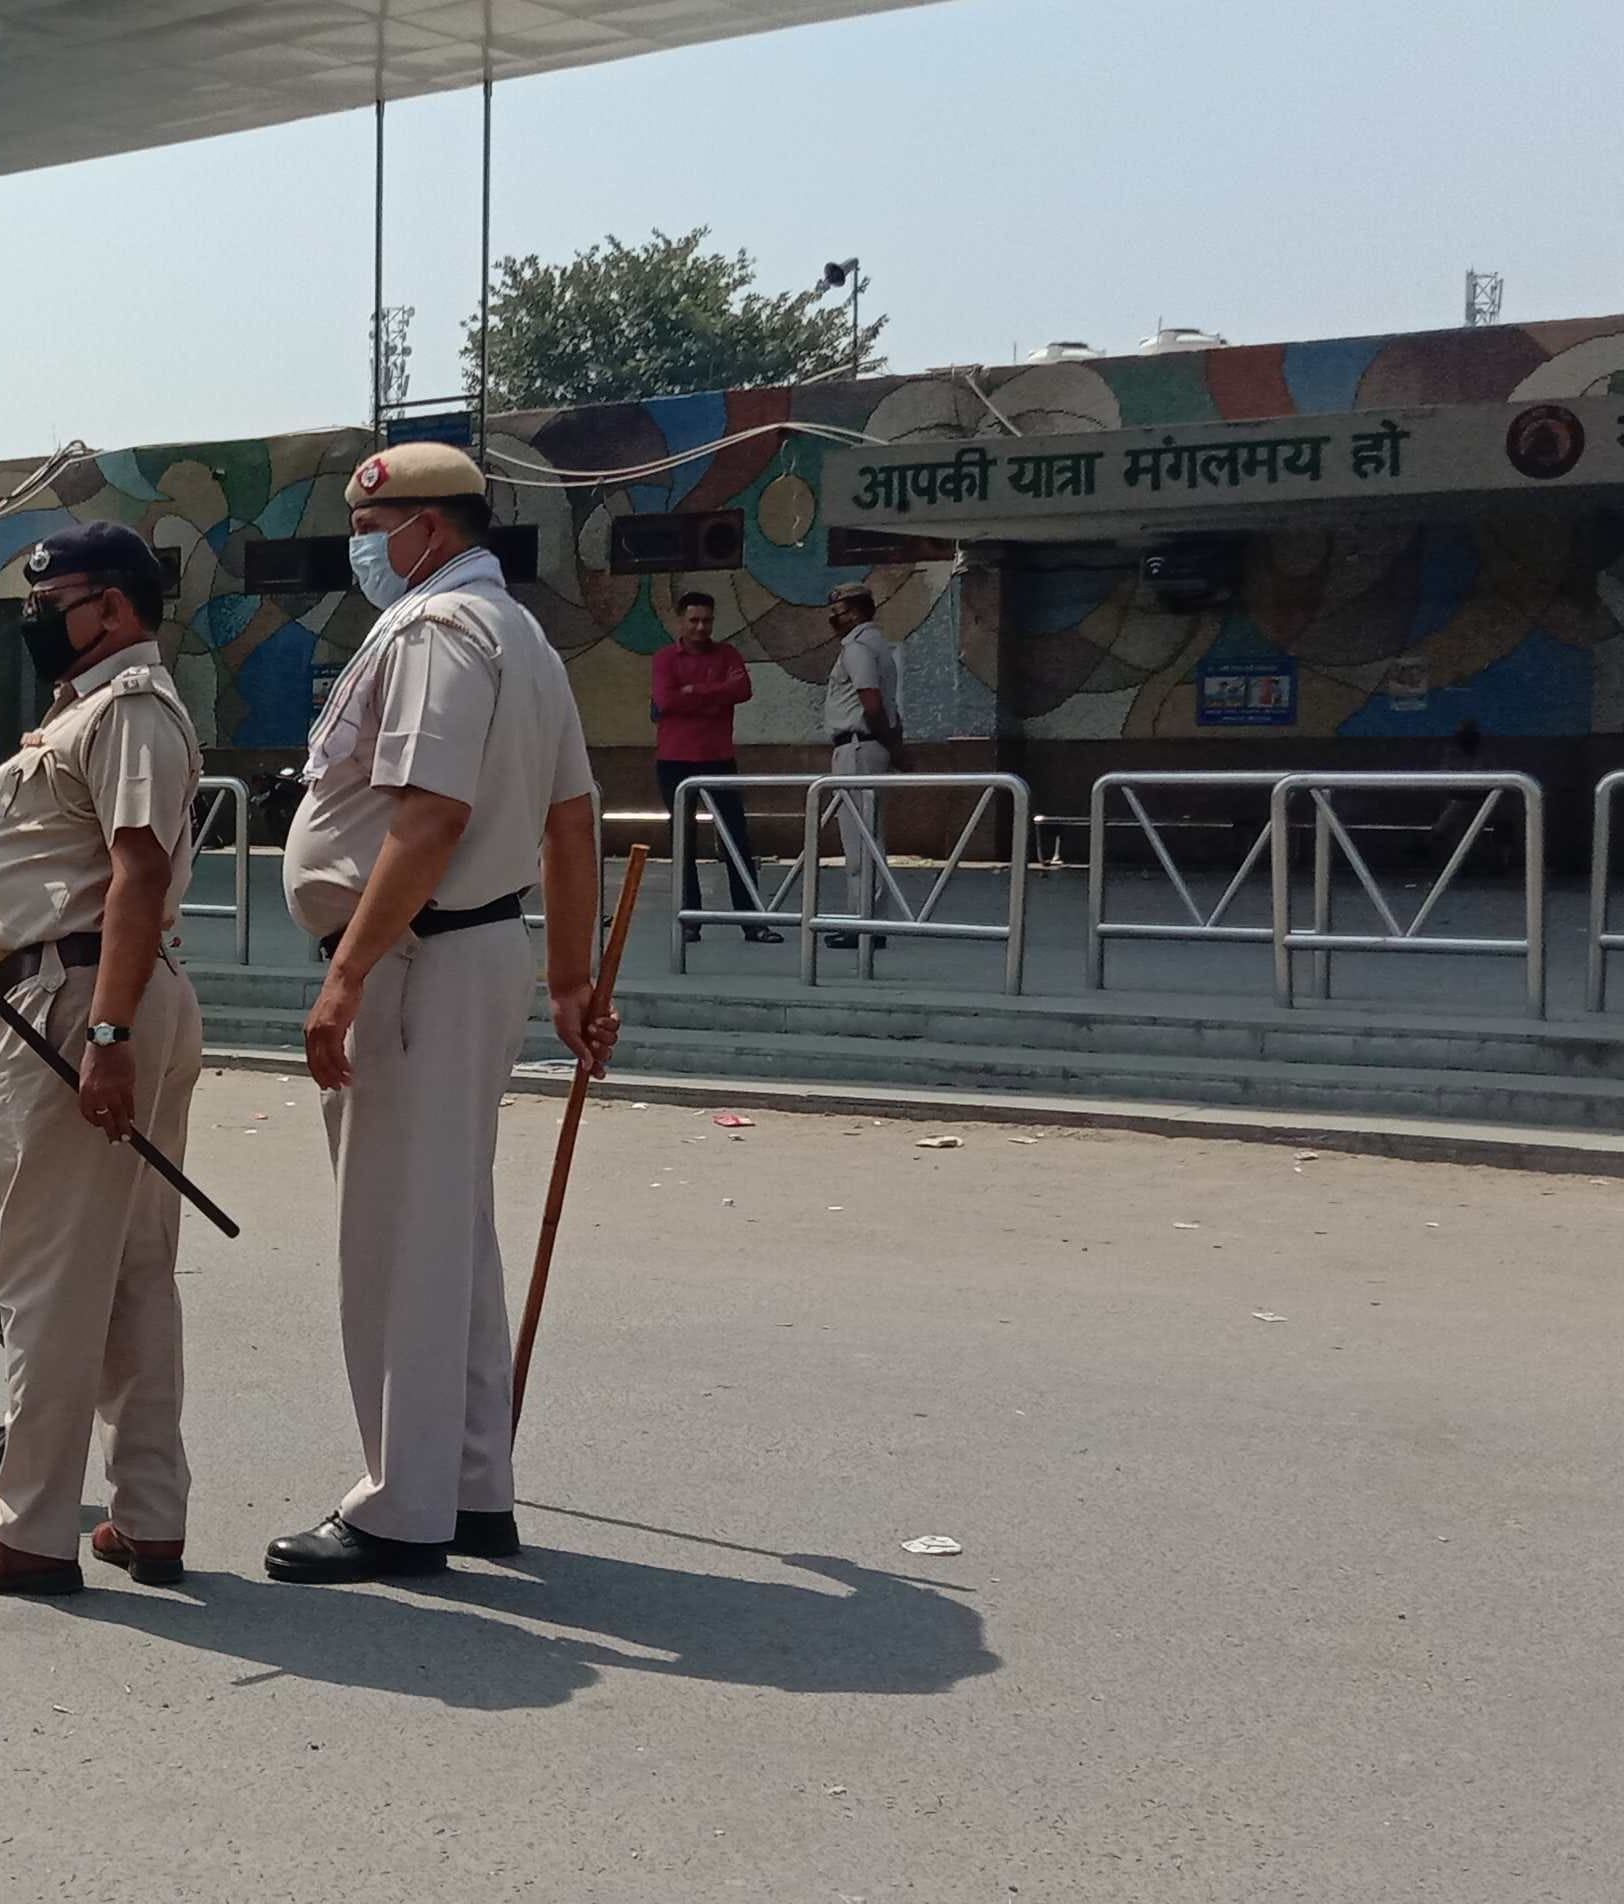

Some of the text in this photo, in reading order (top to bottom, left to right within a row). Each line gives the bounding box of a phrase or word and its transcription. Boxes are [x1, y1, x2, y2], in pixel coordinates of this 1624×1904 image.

[852, 419, 1410, 513] आपकी यात्रा मंगलमय हो
